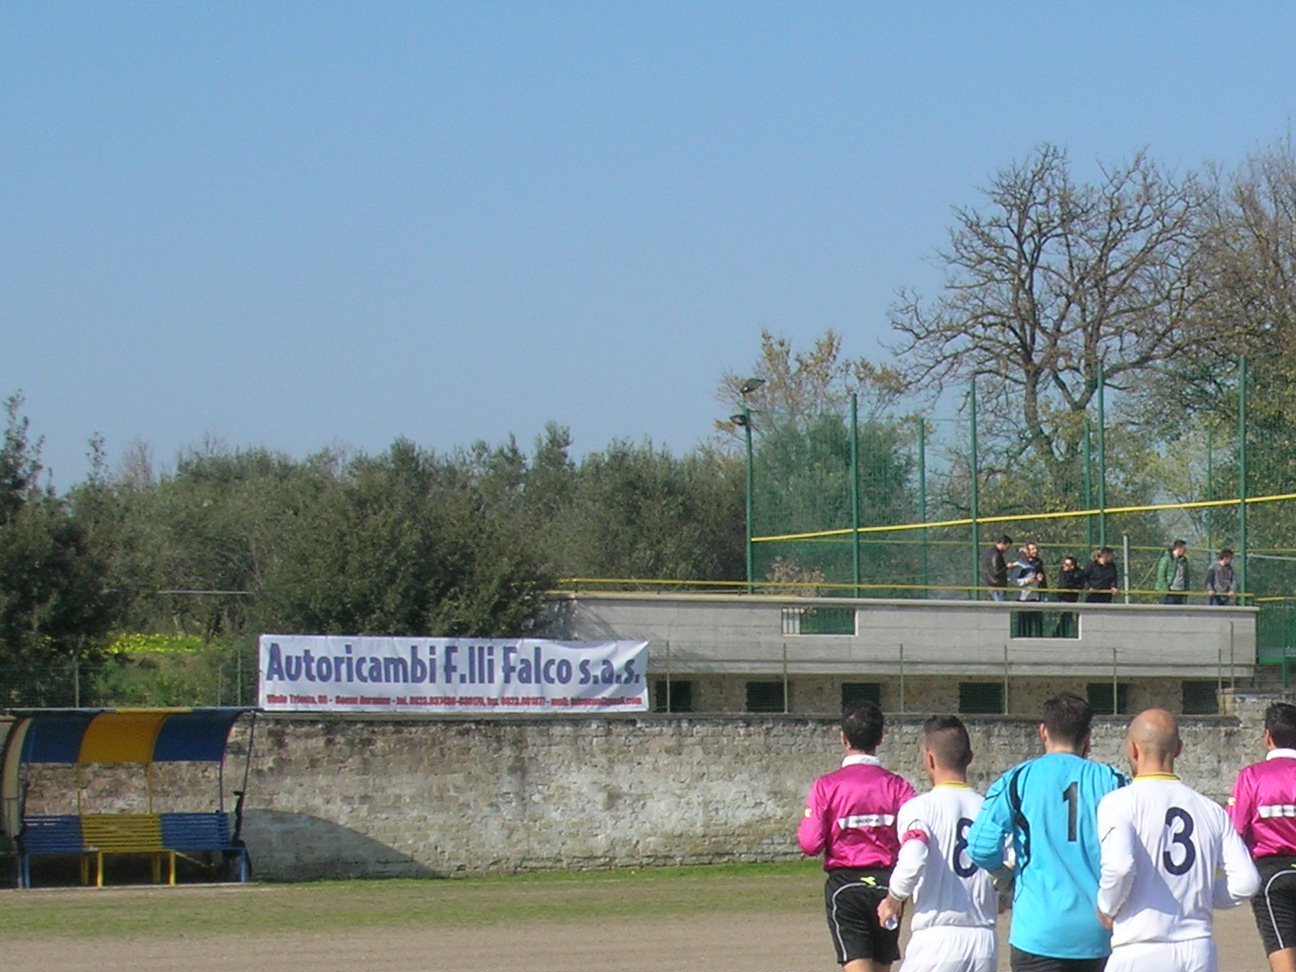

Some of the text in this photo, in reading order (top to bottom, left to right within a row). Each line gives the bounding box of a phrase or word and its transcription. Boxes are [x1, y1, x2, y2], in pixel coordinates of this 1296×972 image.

[266, 643, 641, 685] Autoricambi F.lli Falco s.a.s.
[1062, 781, 1079, 842] 1
[1162, 806, 1196, 876] 3
